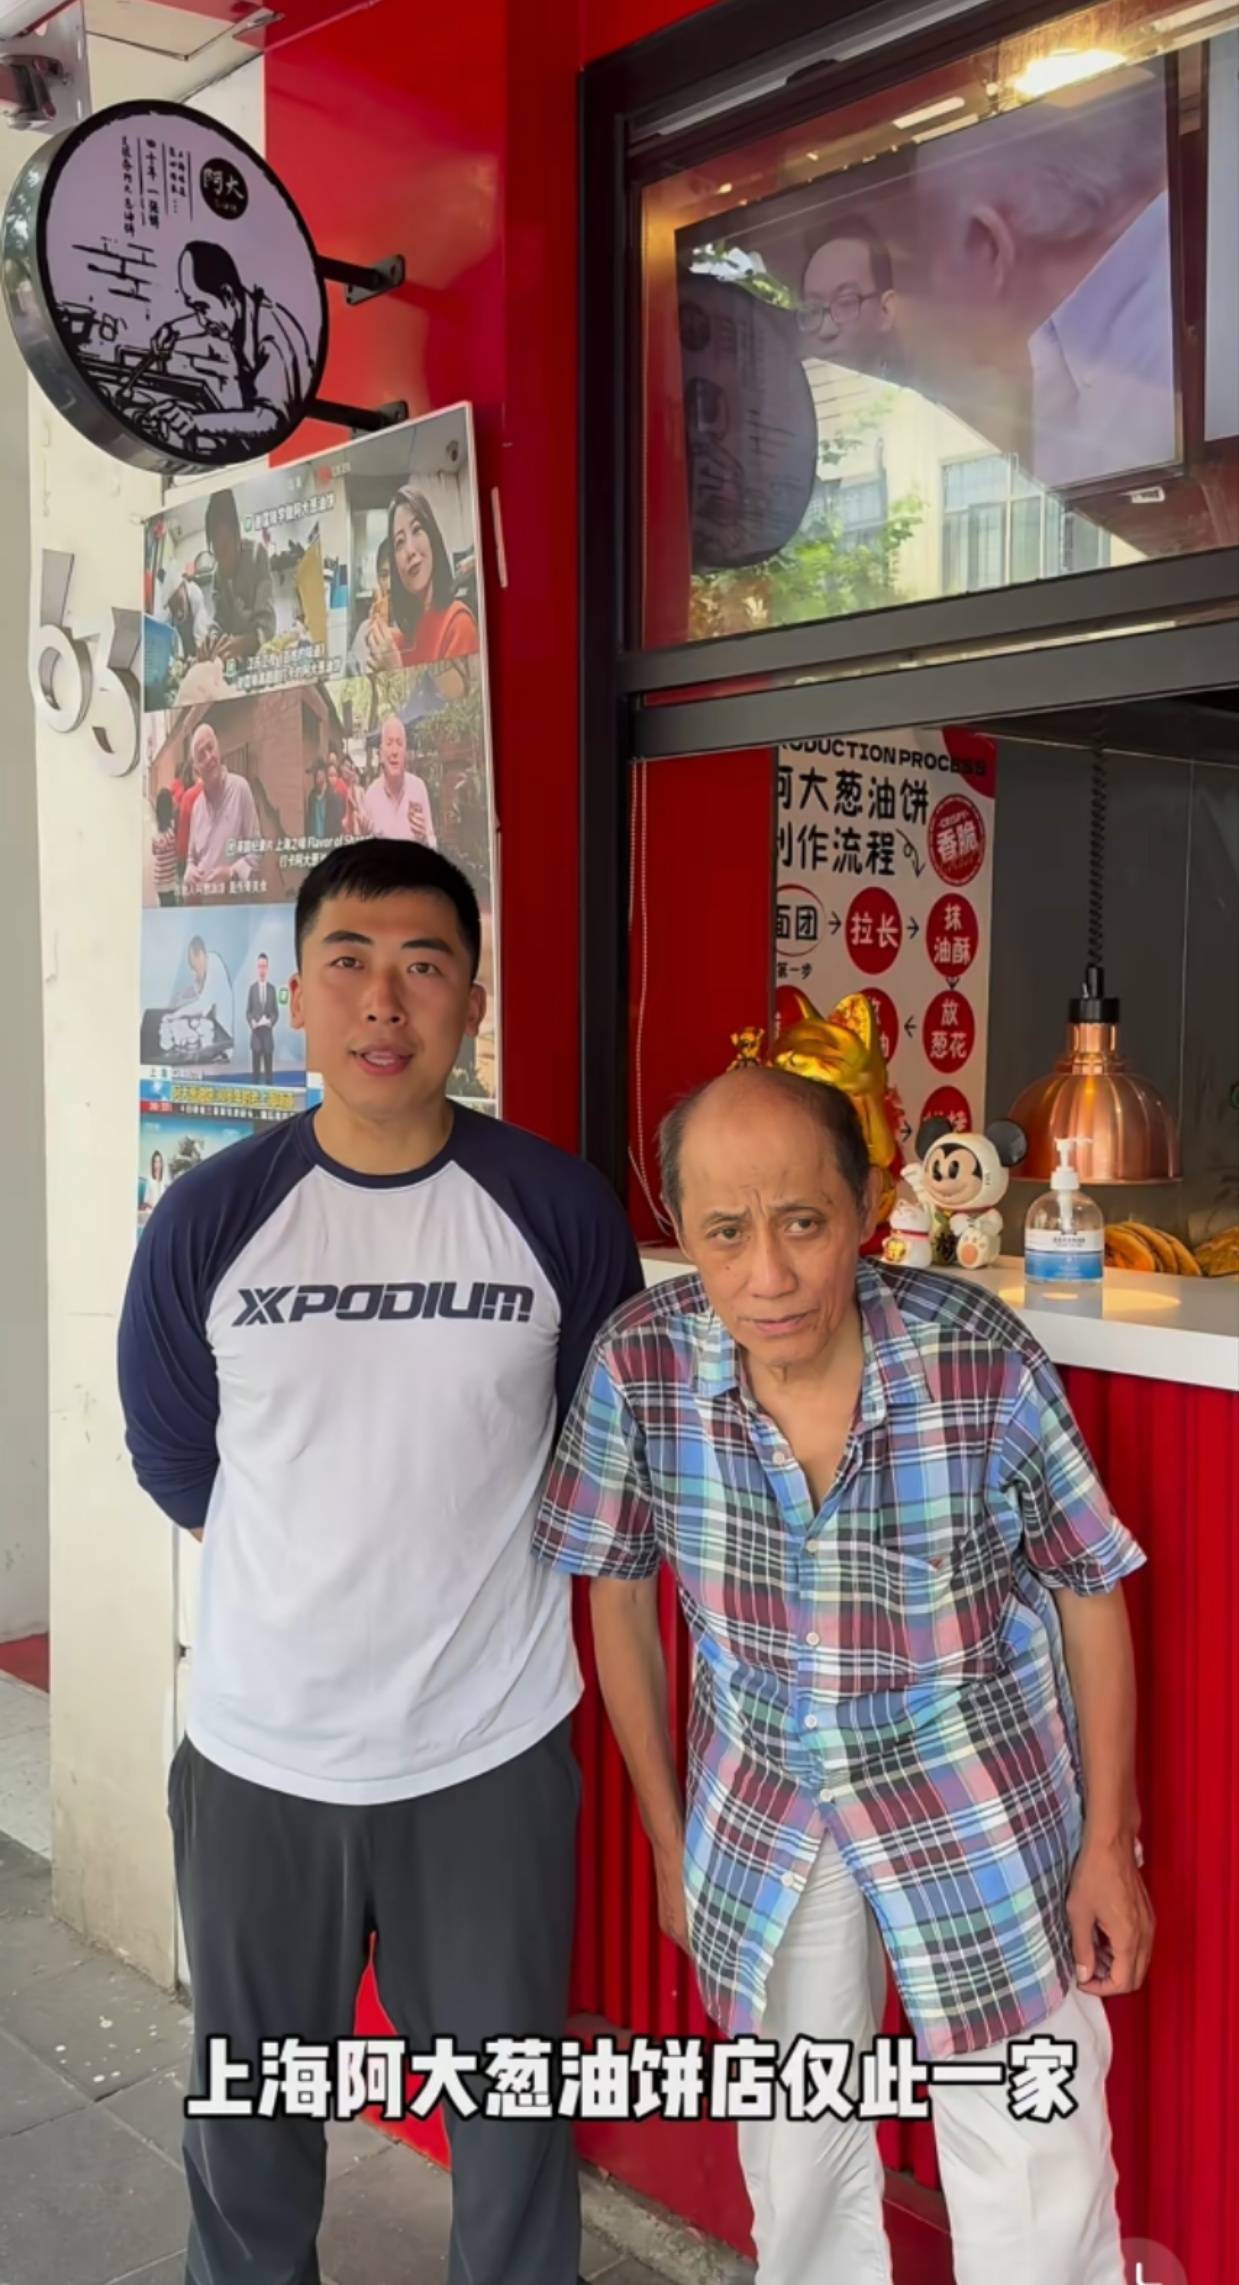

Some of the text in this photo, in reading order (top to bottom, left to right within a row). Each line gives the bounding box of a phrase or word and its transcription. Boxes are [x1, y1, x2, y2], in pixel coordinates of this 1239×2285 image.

[203, 168, 244, 199] 阿大
[937, 820, 979, 863] 香脆
[850, 912, 899, 949] 拉长
[944, 902, 962, 931] 抹
[934, 935, 971, 966] 油酥
[940, 998, 959, 1026] 放
[930, 1030, 968, 1060] 葱花
[231, 1281, 536, 1327] XPODIUM
